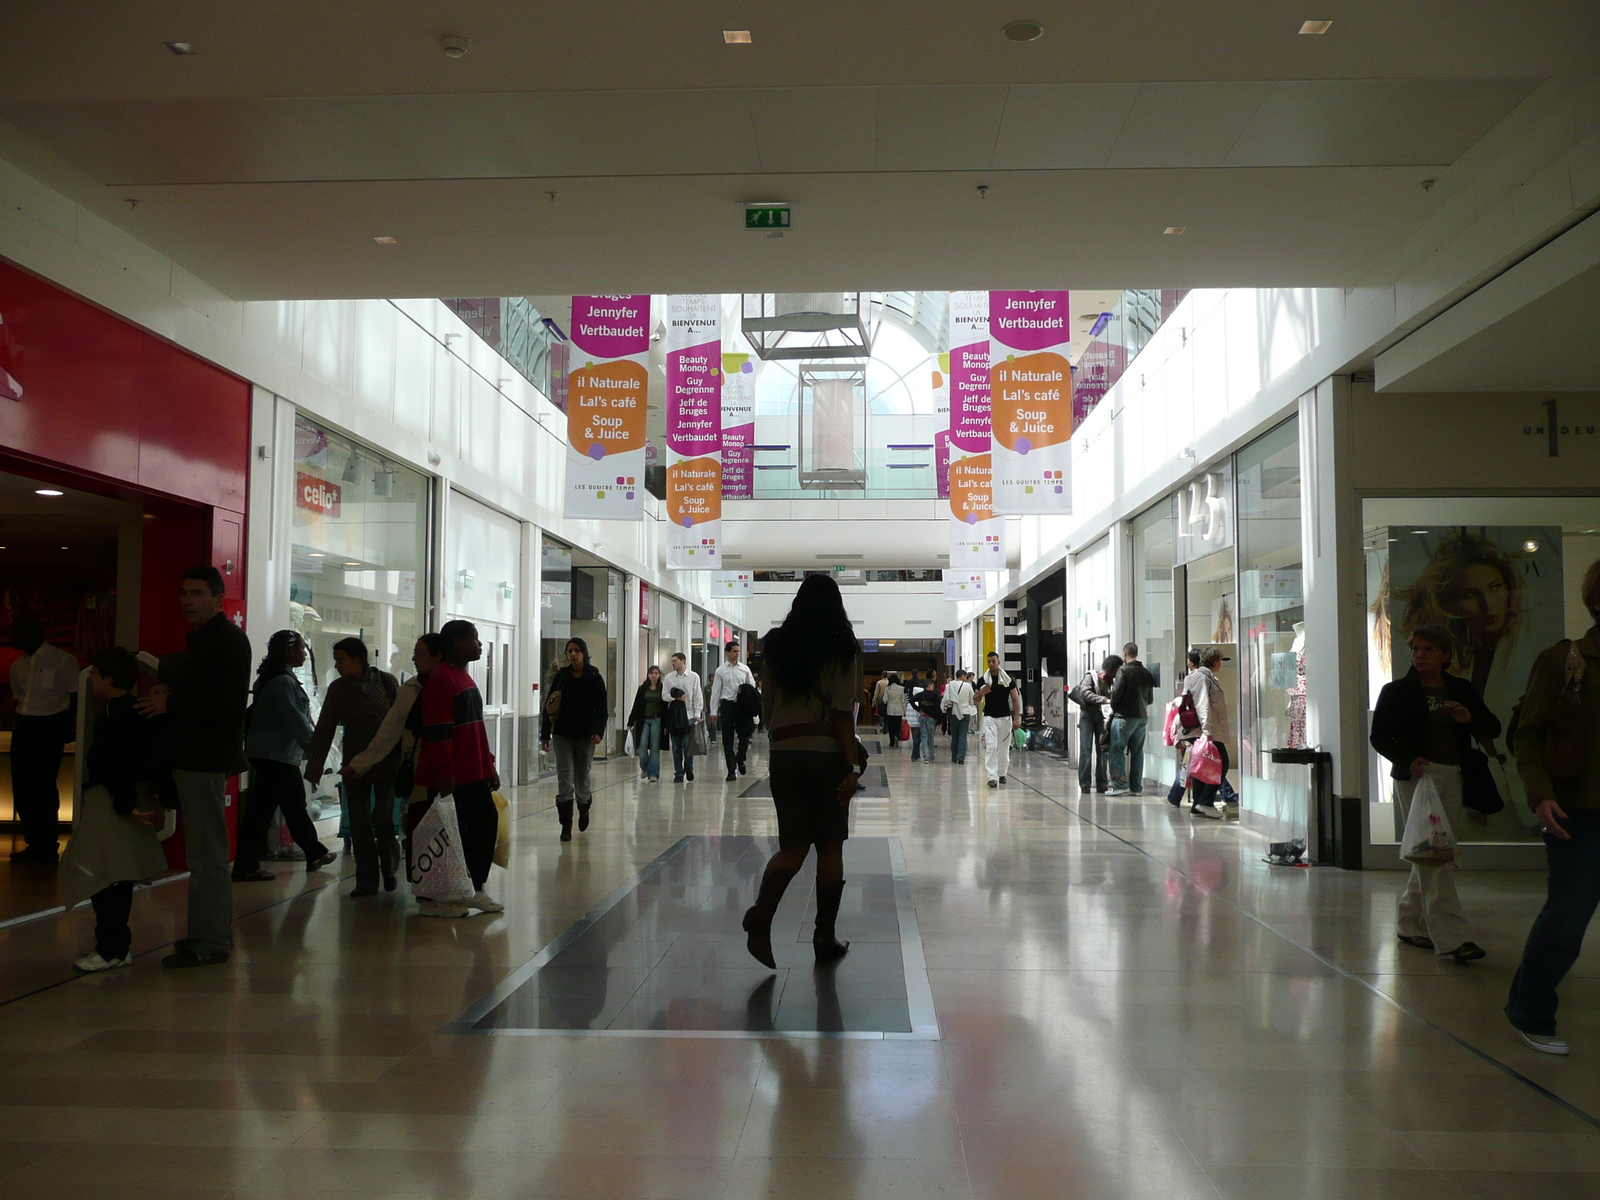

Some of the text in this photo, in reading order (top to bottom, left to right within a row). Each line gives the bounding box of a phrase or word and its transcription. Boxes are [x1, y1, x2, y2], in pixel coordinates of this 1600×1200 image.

[1005, 298, 1056, 312] Jennyfer
[587, 306, 638, 320] Jennyfer
[998, 317, 1063, 328] Vertbaudet
[580, 324, 644, 337] Vertbaudet
[679, 356, 708, 365] Beauty
[963, 352, 990, 361] Beauty
[679, 364, 708, 373] Monop
[963, 360, 990, 370] Monop
[970, 373, 986, 383] Guy
[1000, 370, 1062, 382] il Naturale
[578, 376, 640, 389] il Naturale
[686, 377, 703, 386] Guy
[676, 386, 714, 395] Degrenne
[959, 382, 990, 391] Degren
[963, 395, 978, 403] Jeff
[1003, 389, 1059, 400] Lal's café
[580, 396, 636, 408] Lal's café
[679, 407, 708, 416] Bruges
[963, 404, 991, 413] Bruges
[1016, 408, 1046, 422] Soup
[592, 415, 622, 428] Soup
[677, 420, 713, 430] Jennyfer
[961, 416, 992, 426] Jennyfe
[1009, 421, 1054, 433] & Juice
[1524, 426, 1544, 435] UN
[584, 428, 629, 439] & Juice
[672, 433, 717, 442] Vertbaudet
[672, 470, 716, 478] il Naturale
[965, 466, 992, 474] Natura
[674, 483, 714, 491] Lal's café
[684, 496, 705, 505] Soup
[968, 493, 989, 502] Soup
[688, 505, 710, 513] Juice
[962, 502, 994, 510] & Juice
